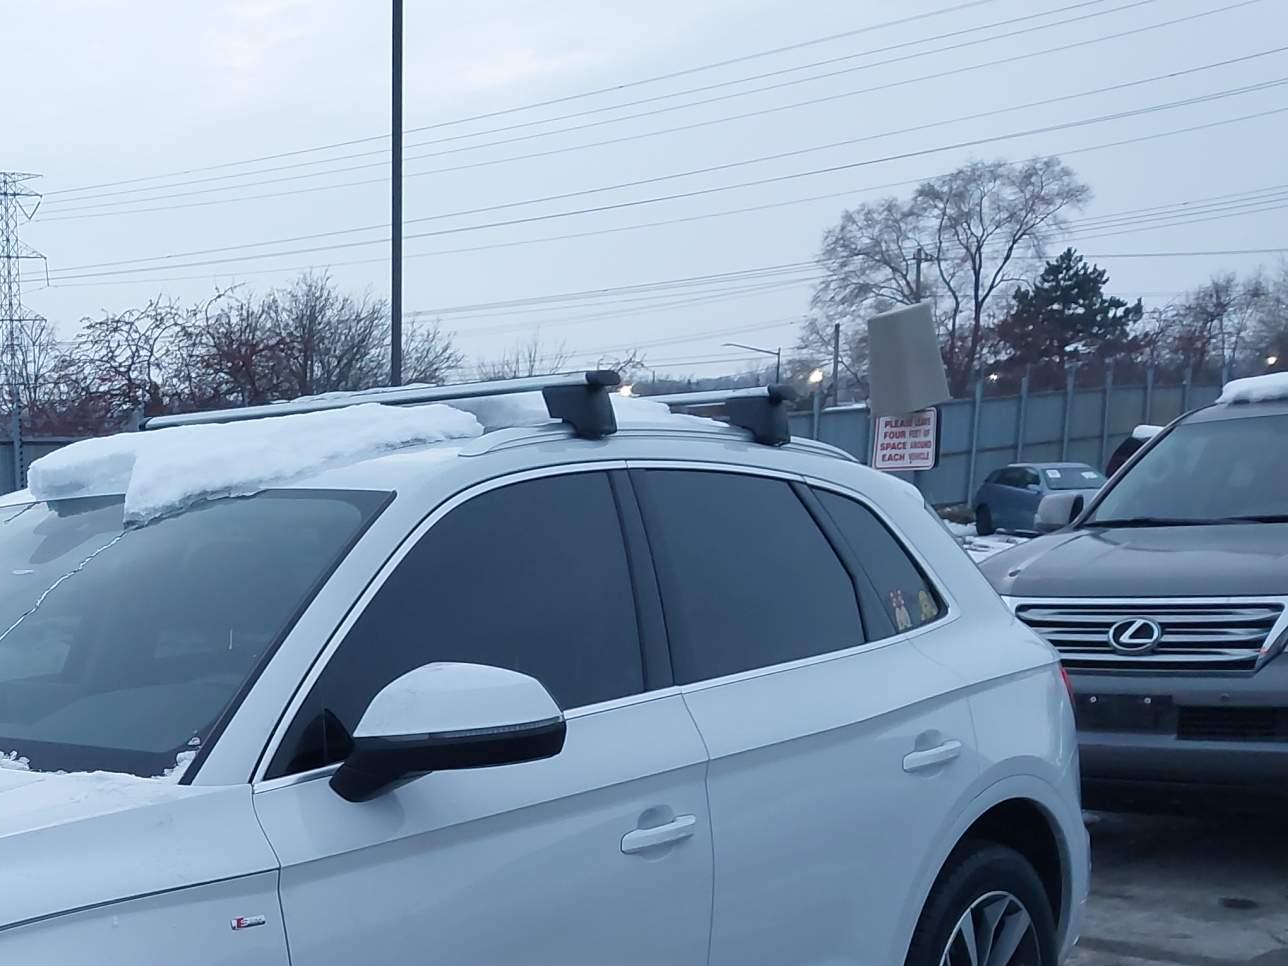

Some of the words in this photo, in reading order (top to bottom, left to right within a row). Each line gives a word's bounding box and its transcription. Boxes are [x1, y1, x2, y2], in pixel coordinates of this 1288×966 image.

[884, 431, 905, 440] FOUR
[880, 442, 906, 451] SPACE
[882, 454, 905, 462] EACH
